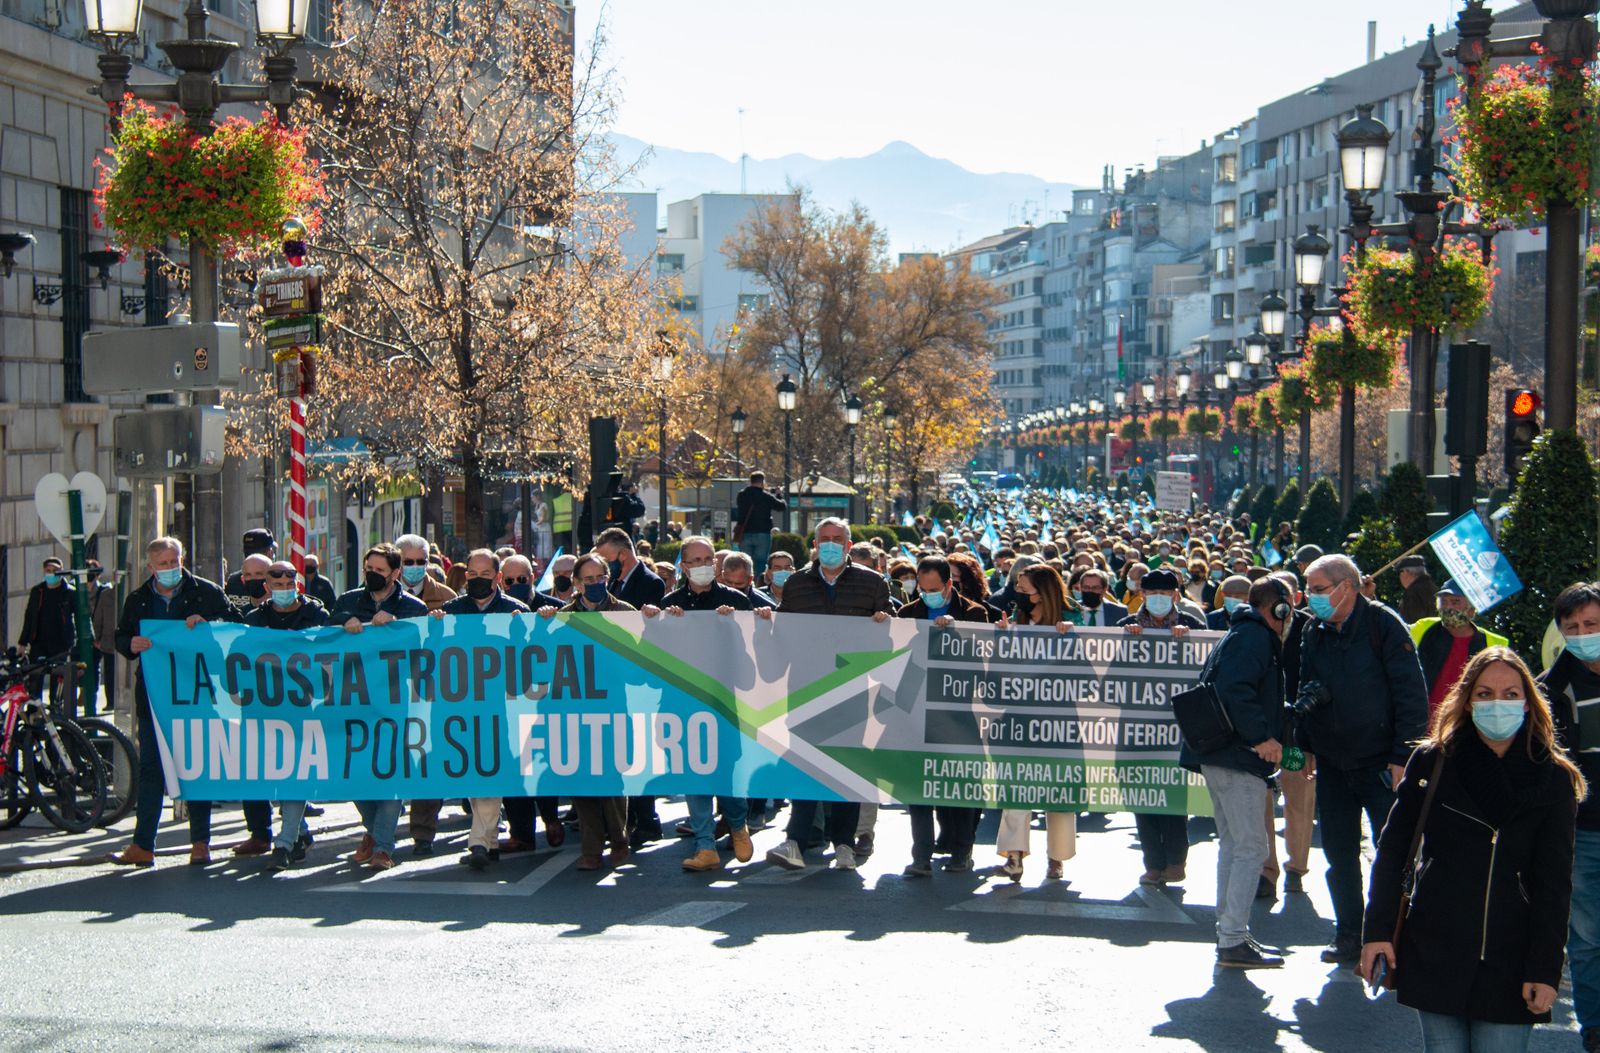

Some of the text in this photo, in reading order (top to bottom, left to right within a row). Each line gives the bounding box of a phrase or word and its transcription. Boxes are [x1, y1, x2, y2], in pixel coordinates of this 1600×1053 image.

[276, 280, 304, 300] TRINEOS
[941, 633, 967, 657] Por
[970, 634, 994, 658] las
[998, 636, 1150, 664] CANALIZACIONES
[1155, 641, 1178, 664] DE
[169, 644, 608, 707] LA COSTA TROPICAL
[942, 674, 969, 698] Por
[973, 675, 996, 699] los
[1001, 677, 1100, 703] ESPIGONES
[1104, 681, 1128, 704] EN
[1132, 682, 1166, 706] LAS
[171, 710, 719, 781] UNIDA POR SU FUTURO
[979, 717, 1006, 740] Por
[1010, 717, 1023, 742] la
[1028, 717, 1119, 746] CONEXIÓN
[923, 759, 1013, 782] PLATAFORMA
[1017, 763, 1051, 783] PARA
[1056, 765, 1082, 784] LAS
[923, 780, 1167, 808] DE LA COSTA TROPICAL DE GRANADA
